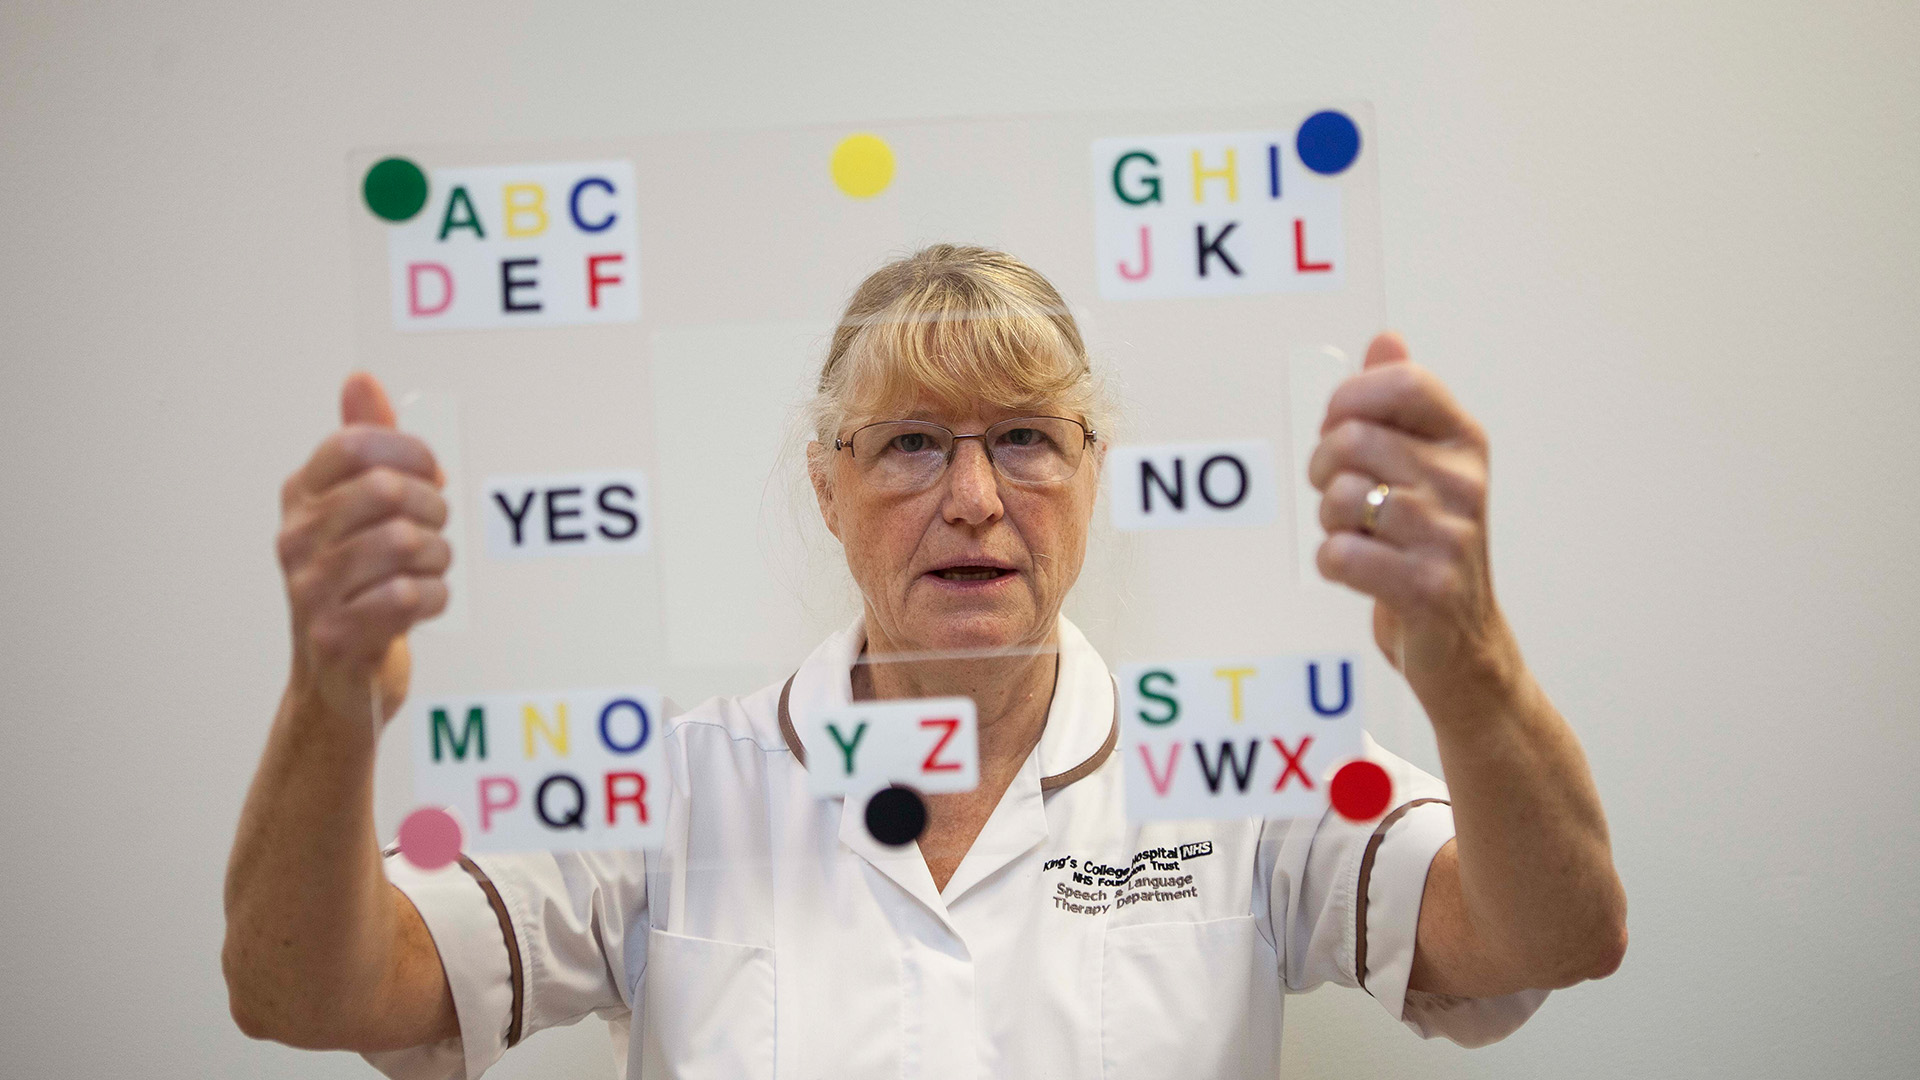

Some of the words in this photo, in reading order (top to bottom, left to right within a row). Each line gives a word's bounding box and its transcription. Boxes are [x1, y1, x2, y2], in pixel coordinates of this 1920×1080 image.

[1139, 452, 1250, 514] NO
[492, 483, 639, 545] YES
[1043, 855, 1078, 872] King's
[1083, 860, 1131, 880] College
[1182, 841, 1212, 860] NHS
[1072, 871, 1094, 886] NHS
[1097, 863, 1146, 887] Founon
[1150, 860, 1180, 871] Trust
[1052, 896, 1112, 916] Therapy
[1116, 886, 1199, 910] Department
[1056, 882, 1108, 902] Speech
[1128, 874, 1194, 891] Language
